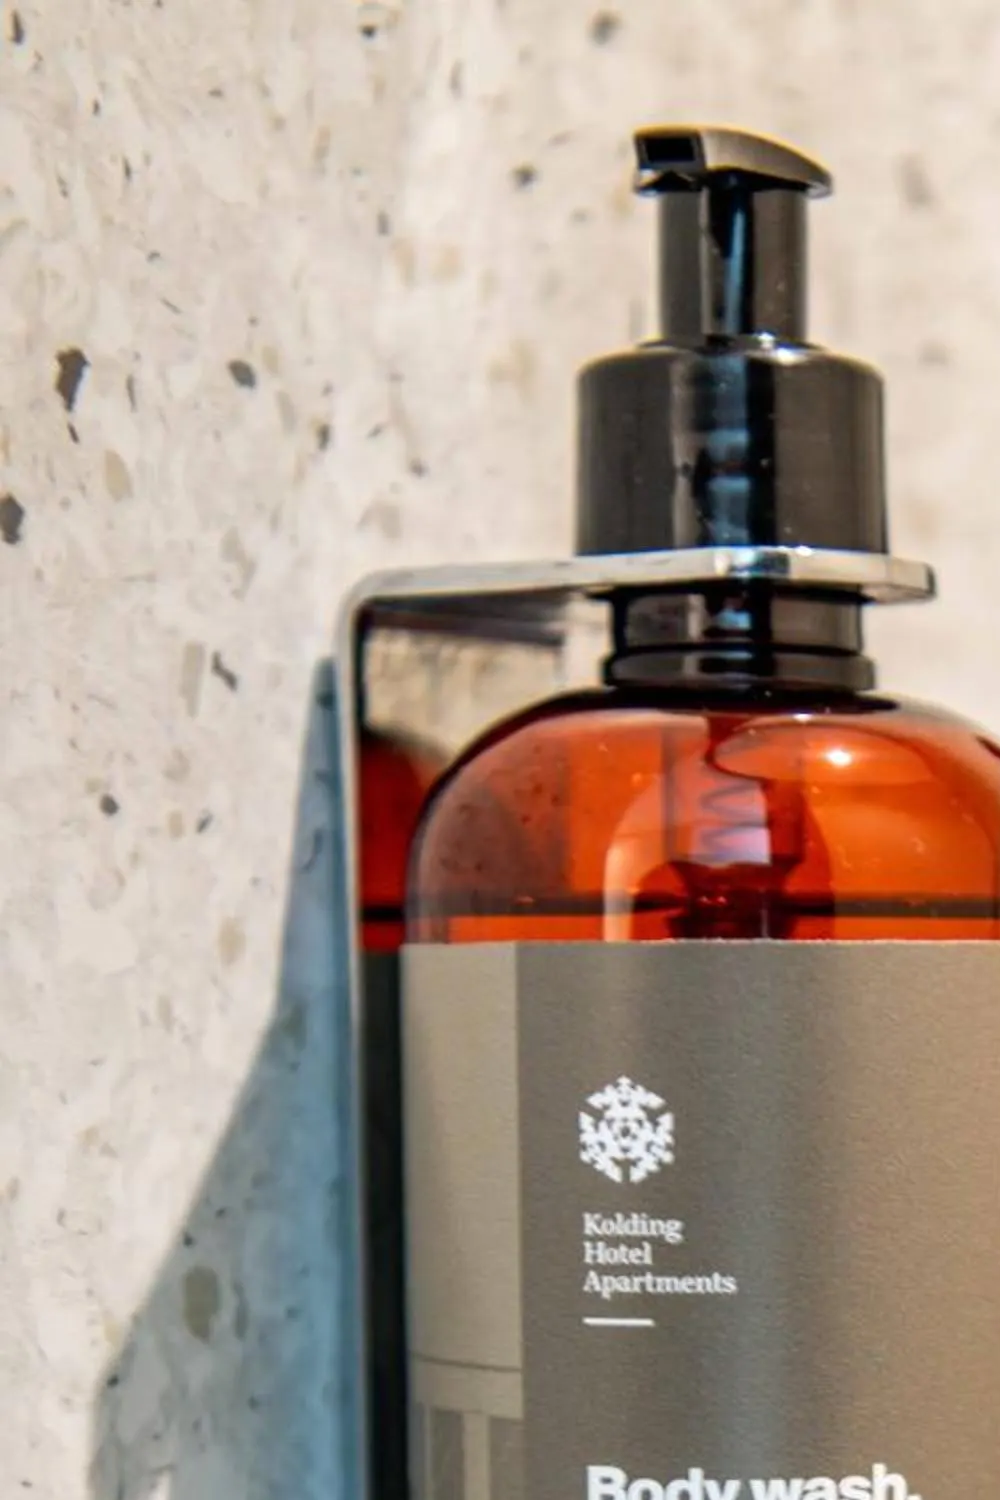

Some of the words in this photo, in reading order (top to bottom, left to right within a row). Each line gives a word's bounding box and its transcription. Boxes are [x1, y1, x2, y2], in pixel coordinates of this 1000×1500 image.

[583, 1212, 683, 1243] Kolding
[583, 1242, 652, 1265] Hotel
[583, 1270, 738, 1299] Apartments
